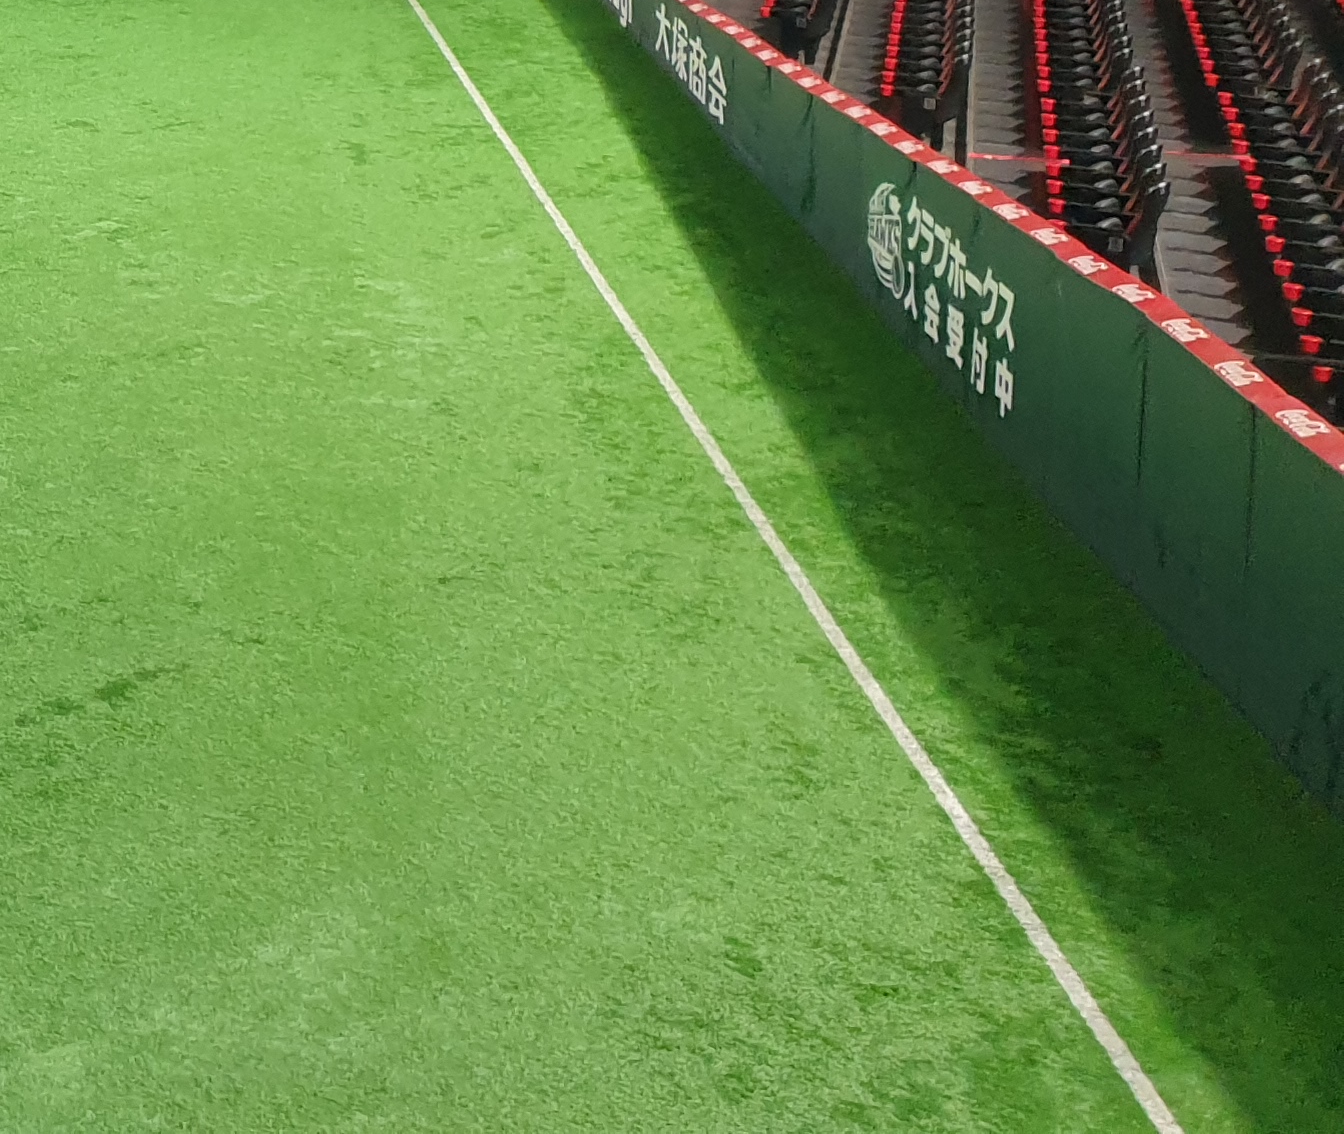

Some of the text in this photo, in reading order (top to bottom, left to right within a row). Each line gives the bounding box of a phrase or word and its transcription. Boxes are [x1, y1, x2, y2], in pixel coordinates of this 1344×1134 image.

[655, 3, 727, 126] 大塚商会
[904, 260, 1014, 418] 入会受付中
[907, 196, 1015, 352] クラブホークス
